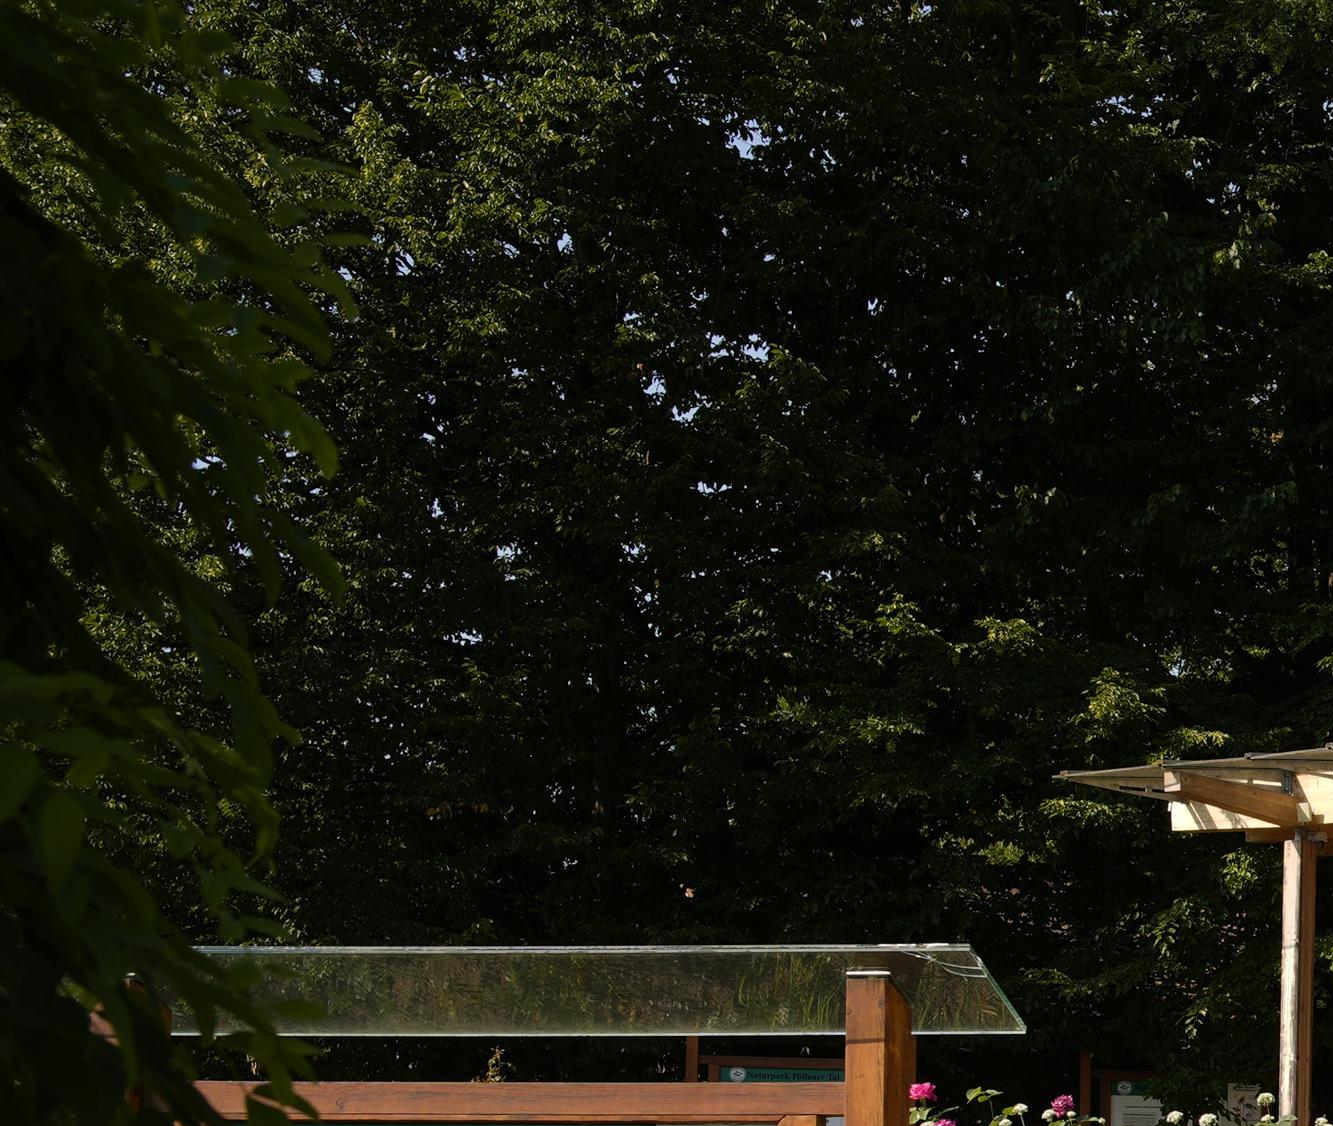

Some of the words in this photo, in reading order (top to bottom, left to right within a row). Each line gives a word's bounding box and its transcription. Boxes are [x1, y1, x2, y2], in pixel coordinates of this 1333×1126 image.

[747, 1071, 790, 1080] Naturpark
[793, 1073, 824, 1081] Pöllauer
[827, 1073, 840, 1081] Tal
